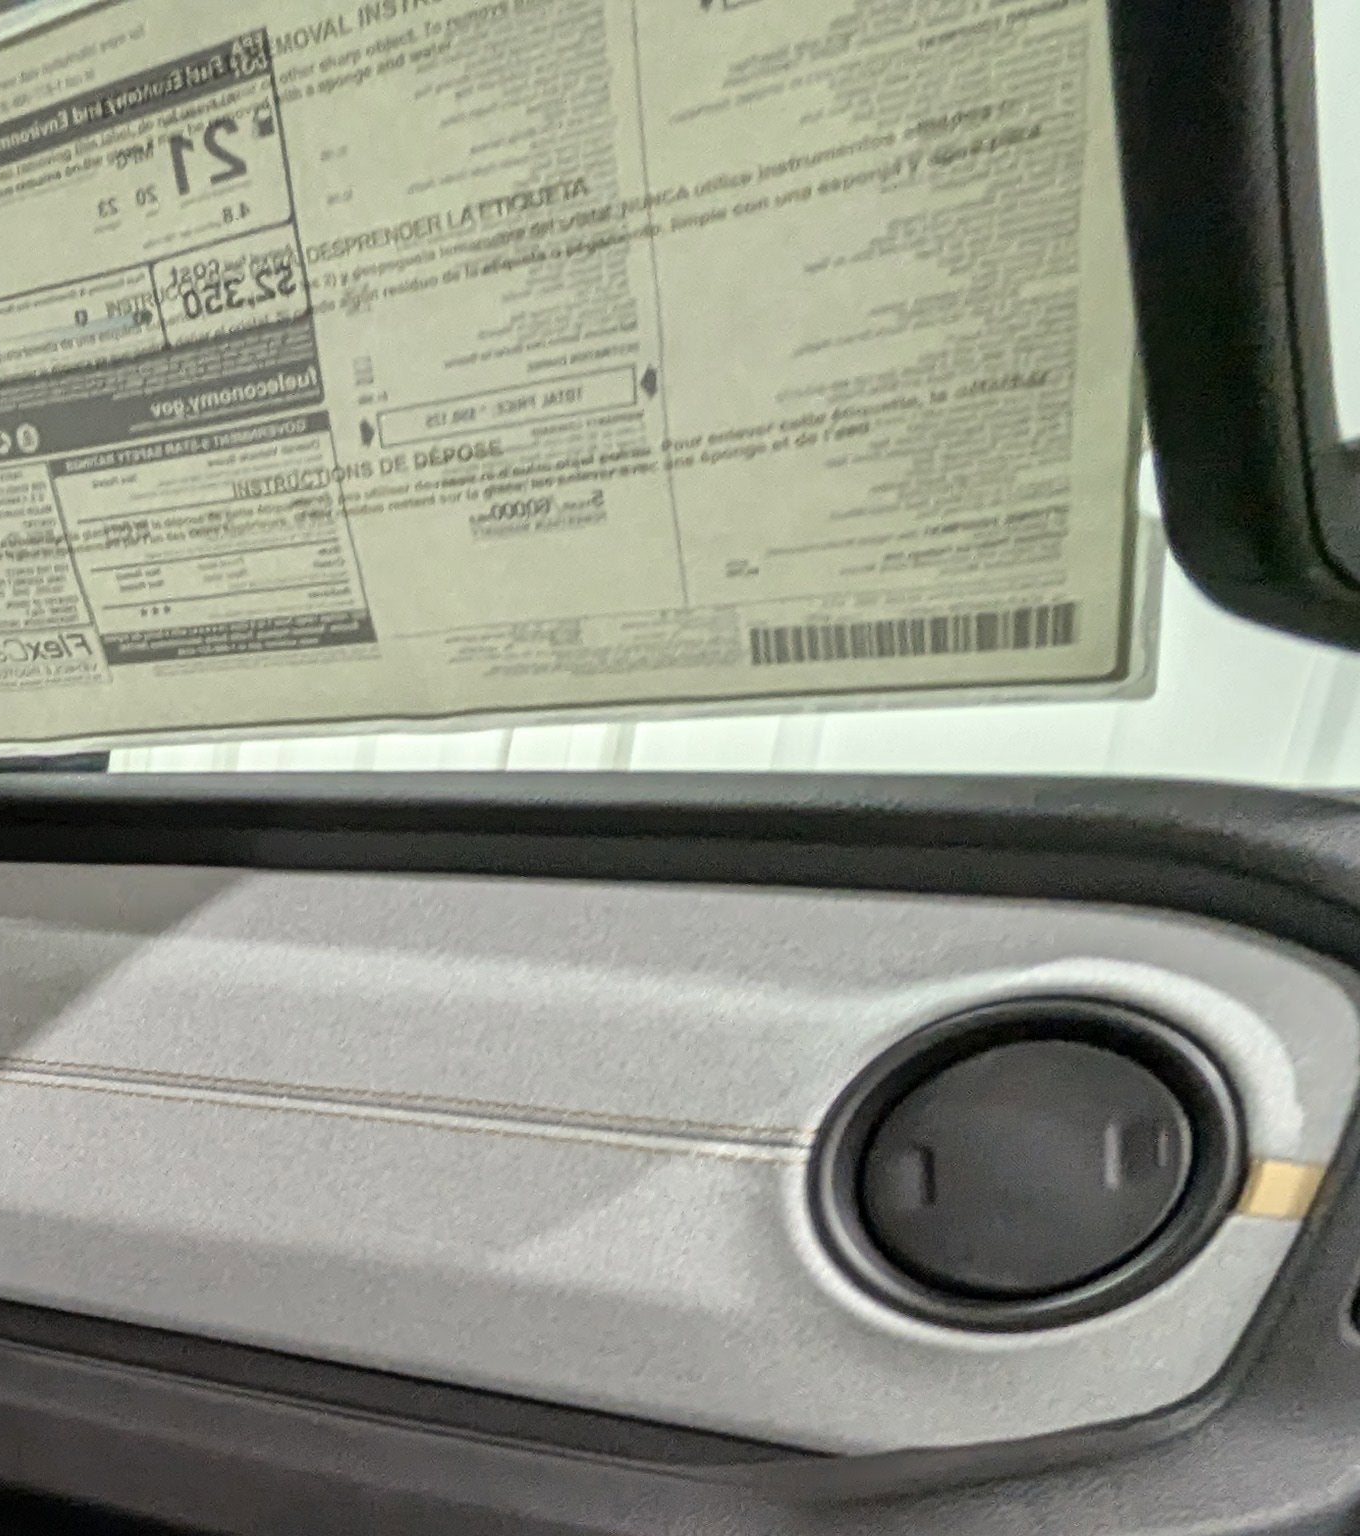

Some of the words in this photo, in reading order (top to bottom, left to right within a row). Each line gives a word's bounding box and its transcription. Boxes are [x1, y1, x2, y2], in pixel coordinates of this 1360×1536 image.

[318, 64, 371, 94] sponge
[377, 51, 405, 74] and
[319, 47, 361, 74] sharp
[621, 184, 690, 218] NUNCA
[694, 168, 752, 200] utilice
[758, 126, 895, 184] instrumentos
[383, 272, 438, 302] residuo
[443, 266, 460, 287] de
[670, 204, 727, 235] limpie
[733, 193, 770, 219] con
[774, 181, 812, 208] una
[817, 157, 901, 197] esponja
[446, 204, 473, 227] LA
[701, 437, 766, 465] éponge
[794, 429, 816, 450] de
[708, 420, 773, 448] enlever
[780, 411, 825, 436] cette
[232, 460, 373, 499] INSTRUCTIONS
[379, 454, 408, 475] DE
